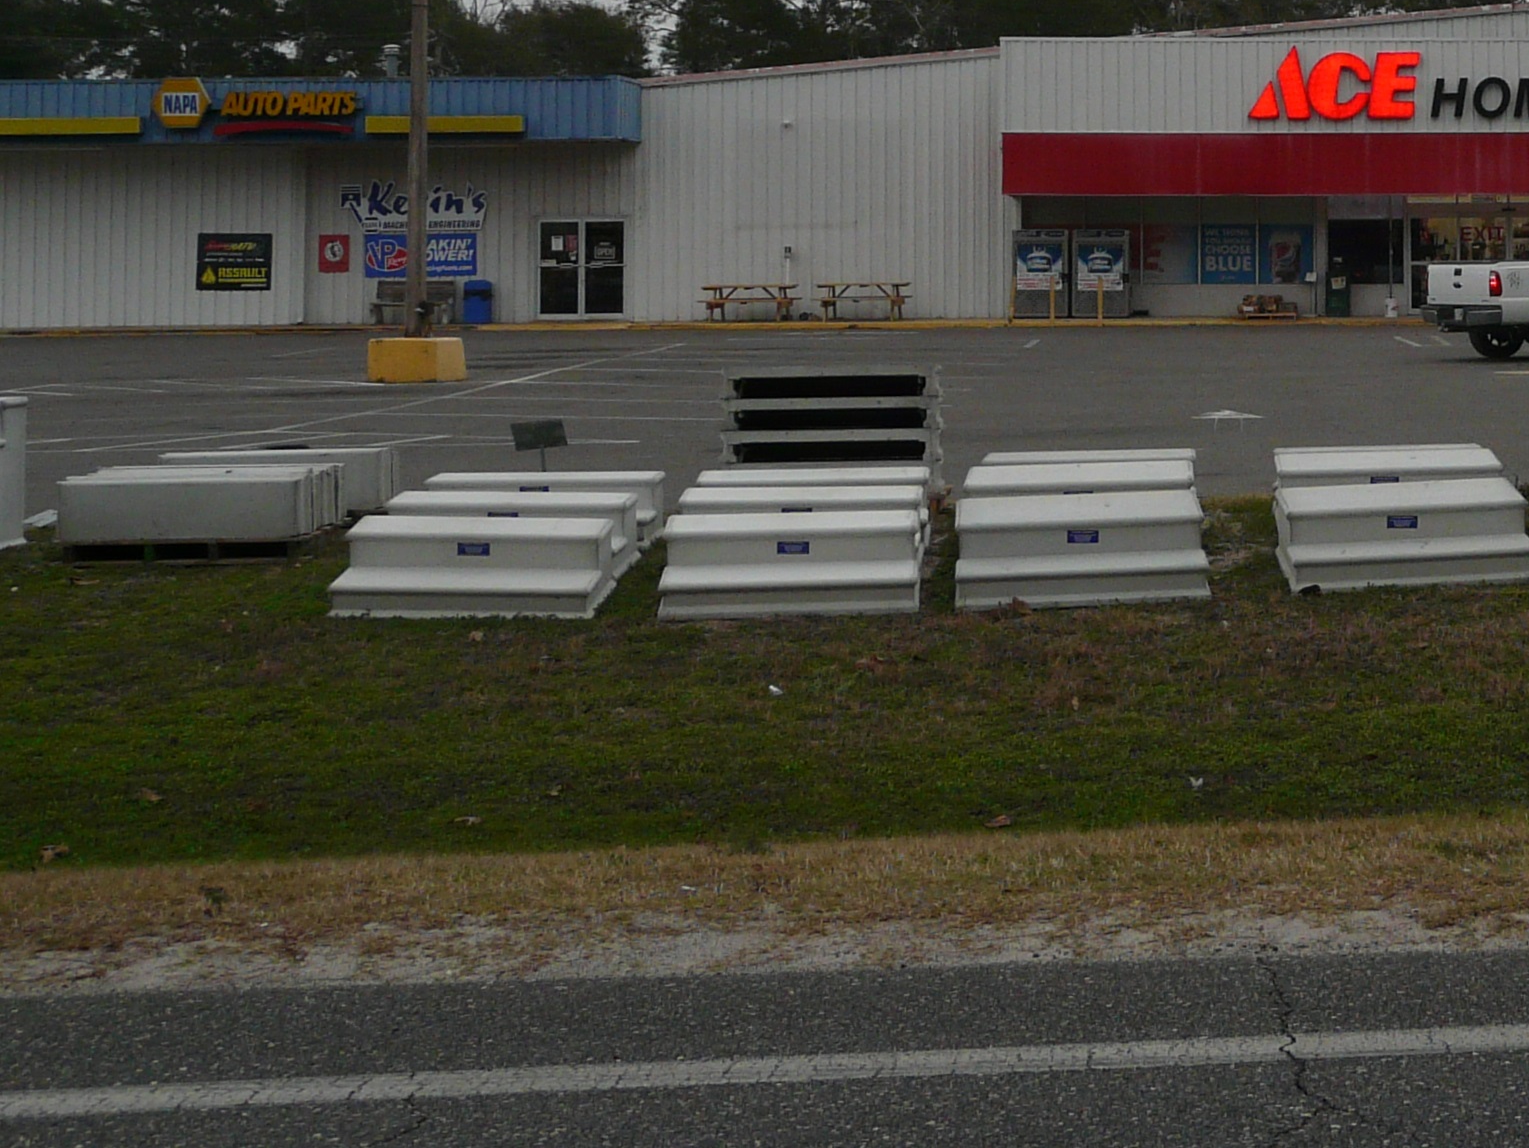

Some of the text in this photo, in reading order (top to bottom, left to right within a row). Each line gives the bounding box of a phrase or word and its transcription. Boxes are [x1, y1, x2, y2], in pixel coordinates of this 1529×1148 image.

[1248, 45, 1421, 120] ACE
[163, 94, 198, 114] NAPA
[220, 91, 357, 116] AUTO PARTS
[368, 180, 486, 216] Kein's
[1461, 226, 1504, 242] EXIT
[426, 238, 473, 250] AKIN'
[1205, 244, 1251, 254] CHOOSE
[425, 250, 474, 261] OWER!
[1205, 255, 1253, 271] BLUE
[218, 267, 268, 278] ASSAULT
